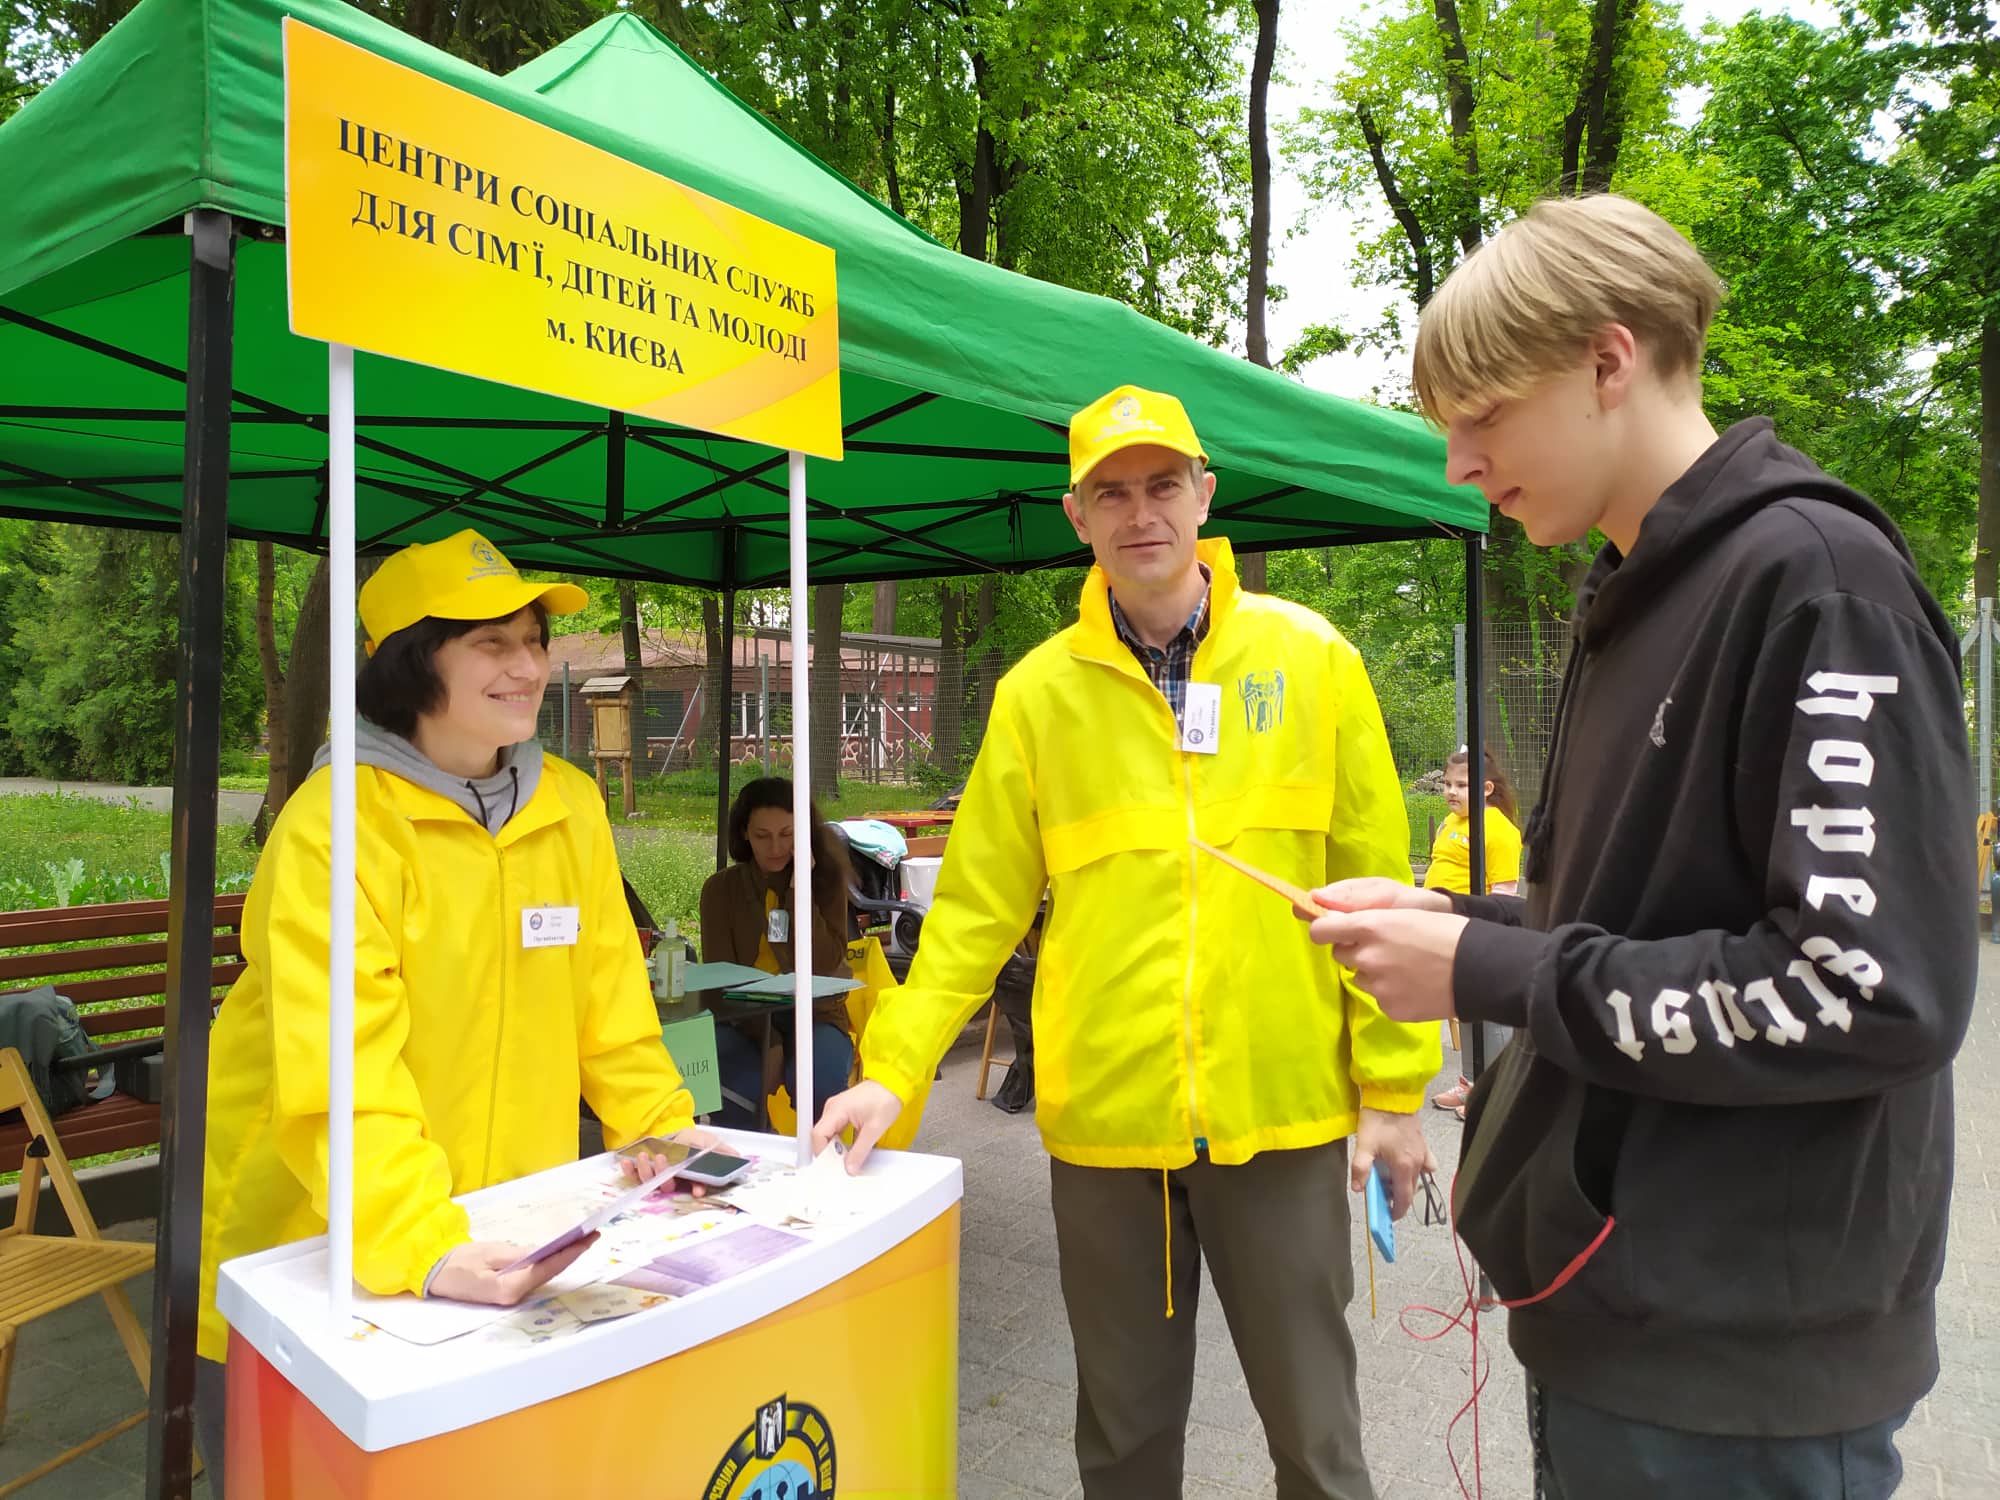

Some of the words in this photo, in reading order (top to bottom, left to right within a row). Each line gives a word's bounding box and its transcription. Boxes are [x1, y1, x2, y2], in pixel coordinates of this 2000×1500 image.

[338, 117, 499, 207] ЦЕНТРИ
[510, 184, 720, 286] СОЦІАЛЬНИХ
[726, 264, 816, 318] СЛУЖБ
[352, 189, 436, 246] ДЛЯ
[562, 258, 656, 316] ДІТЕЙ
[664, 292, 700, 330] ТА
[708, 306, 808, 363] МОЛОДІ
[546, 317, 576, 346] м.
[584, 320, 685, 375] КИЄВА
